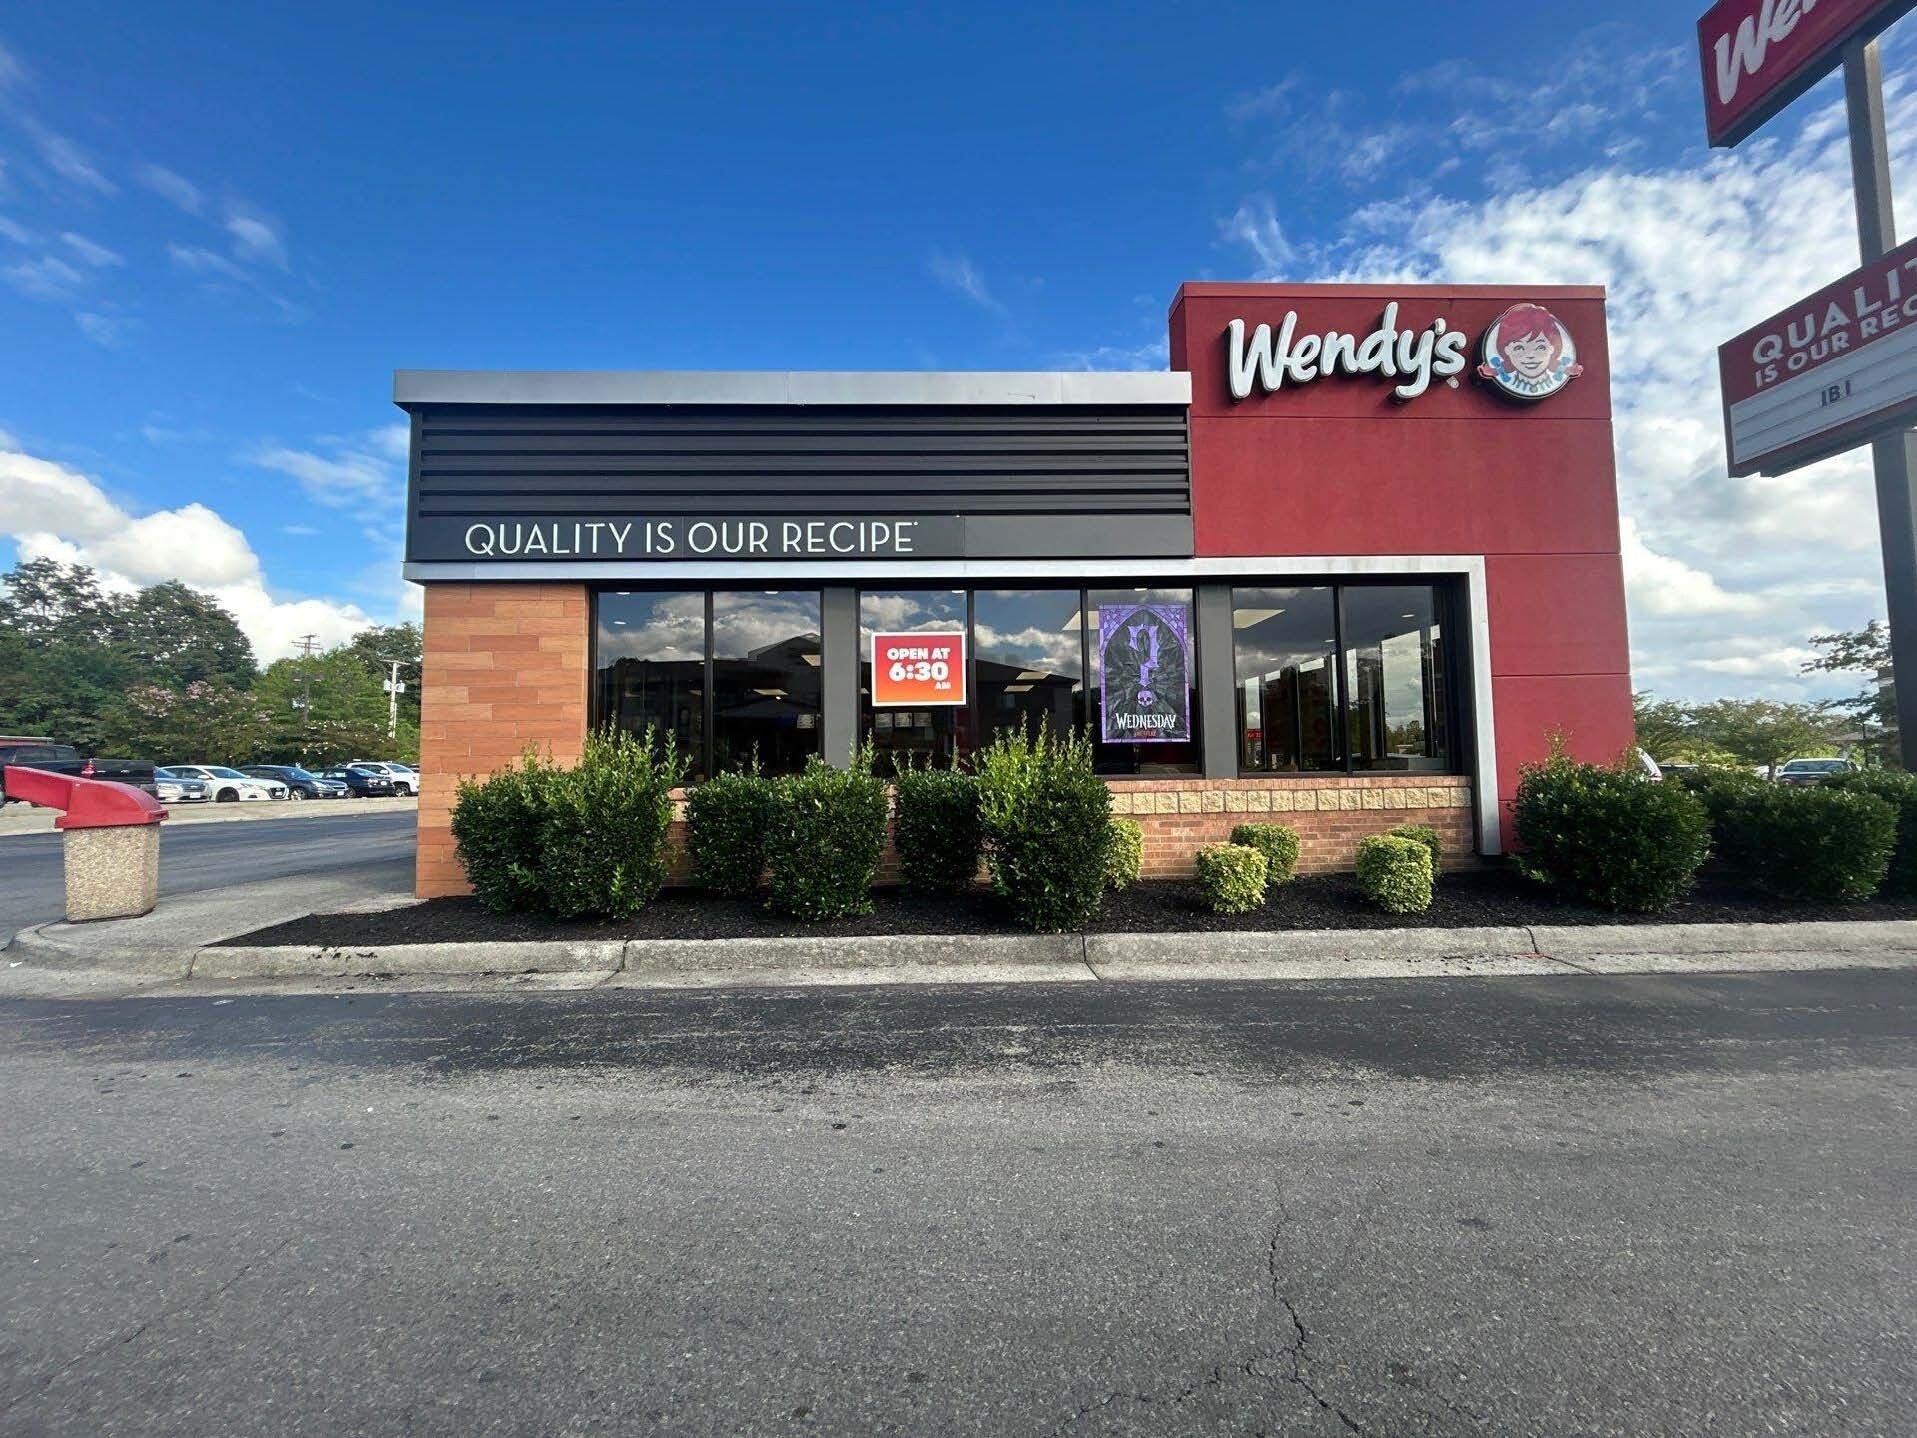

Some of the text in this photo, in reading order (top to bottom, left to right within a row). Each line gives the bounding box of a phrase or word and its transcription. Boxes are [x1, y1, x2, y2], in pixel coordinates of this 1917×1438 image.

[1714, 0, 1816, 104] We
[1228, 302, 1467, 398] Wendy's
[1755, 364, 1778, 388] IS
[1787, 332, 1850, 370] OUR
[465, 521, 914, 556] QUALITY IS OUR RECIPE
[887, 648, 951, 660] OPEN AT
[889, 662, 949, 682] 6:30
[935, 682, 951, 690] AM
[1115, 712, 1176, 730] WEDNESDAY
